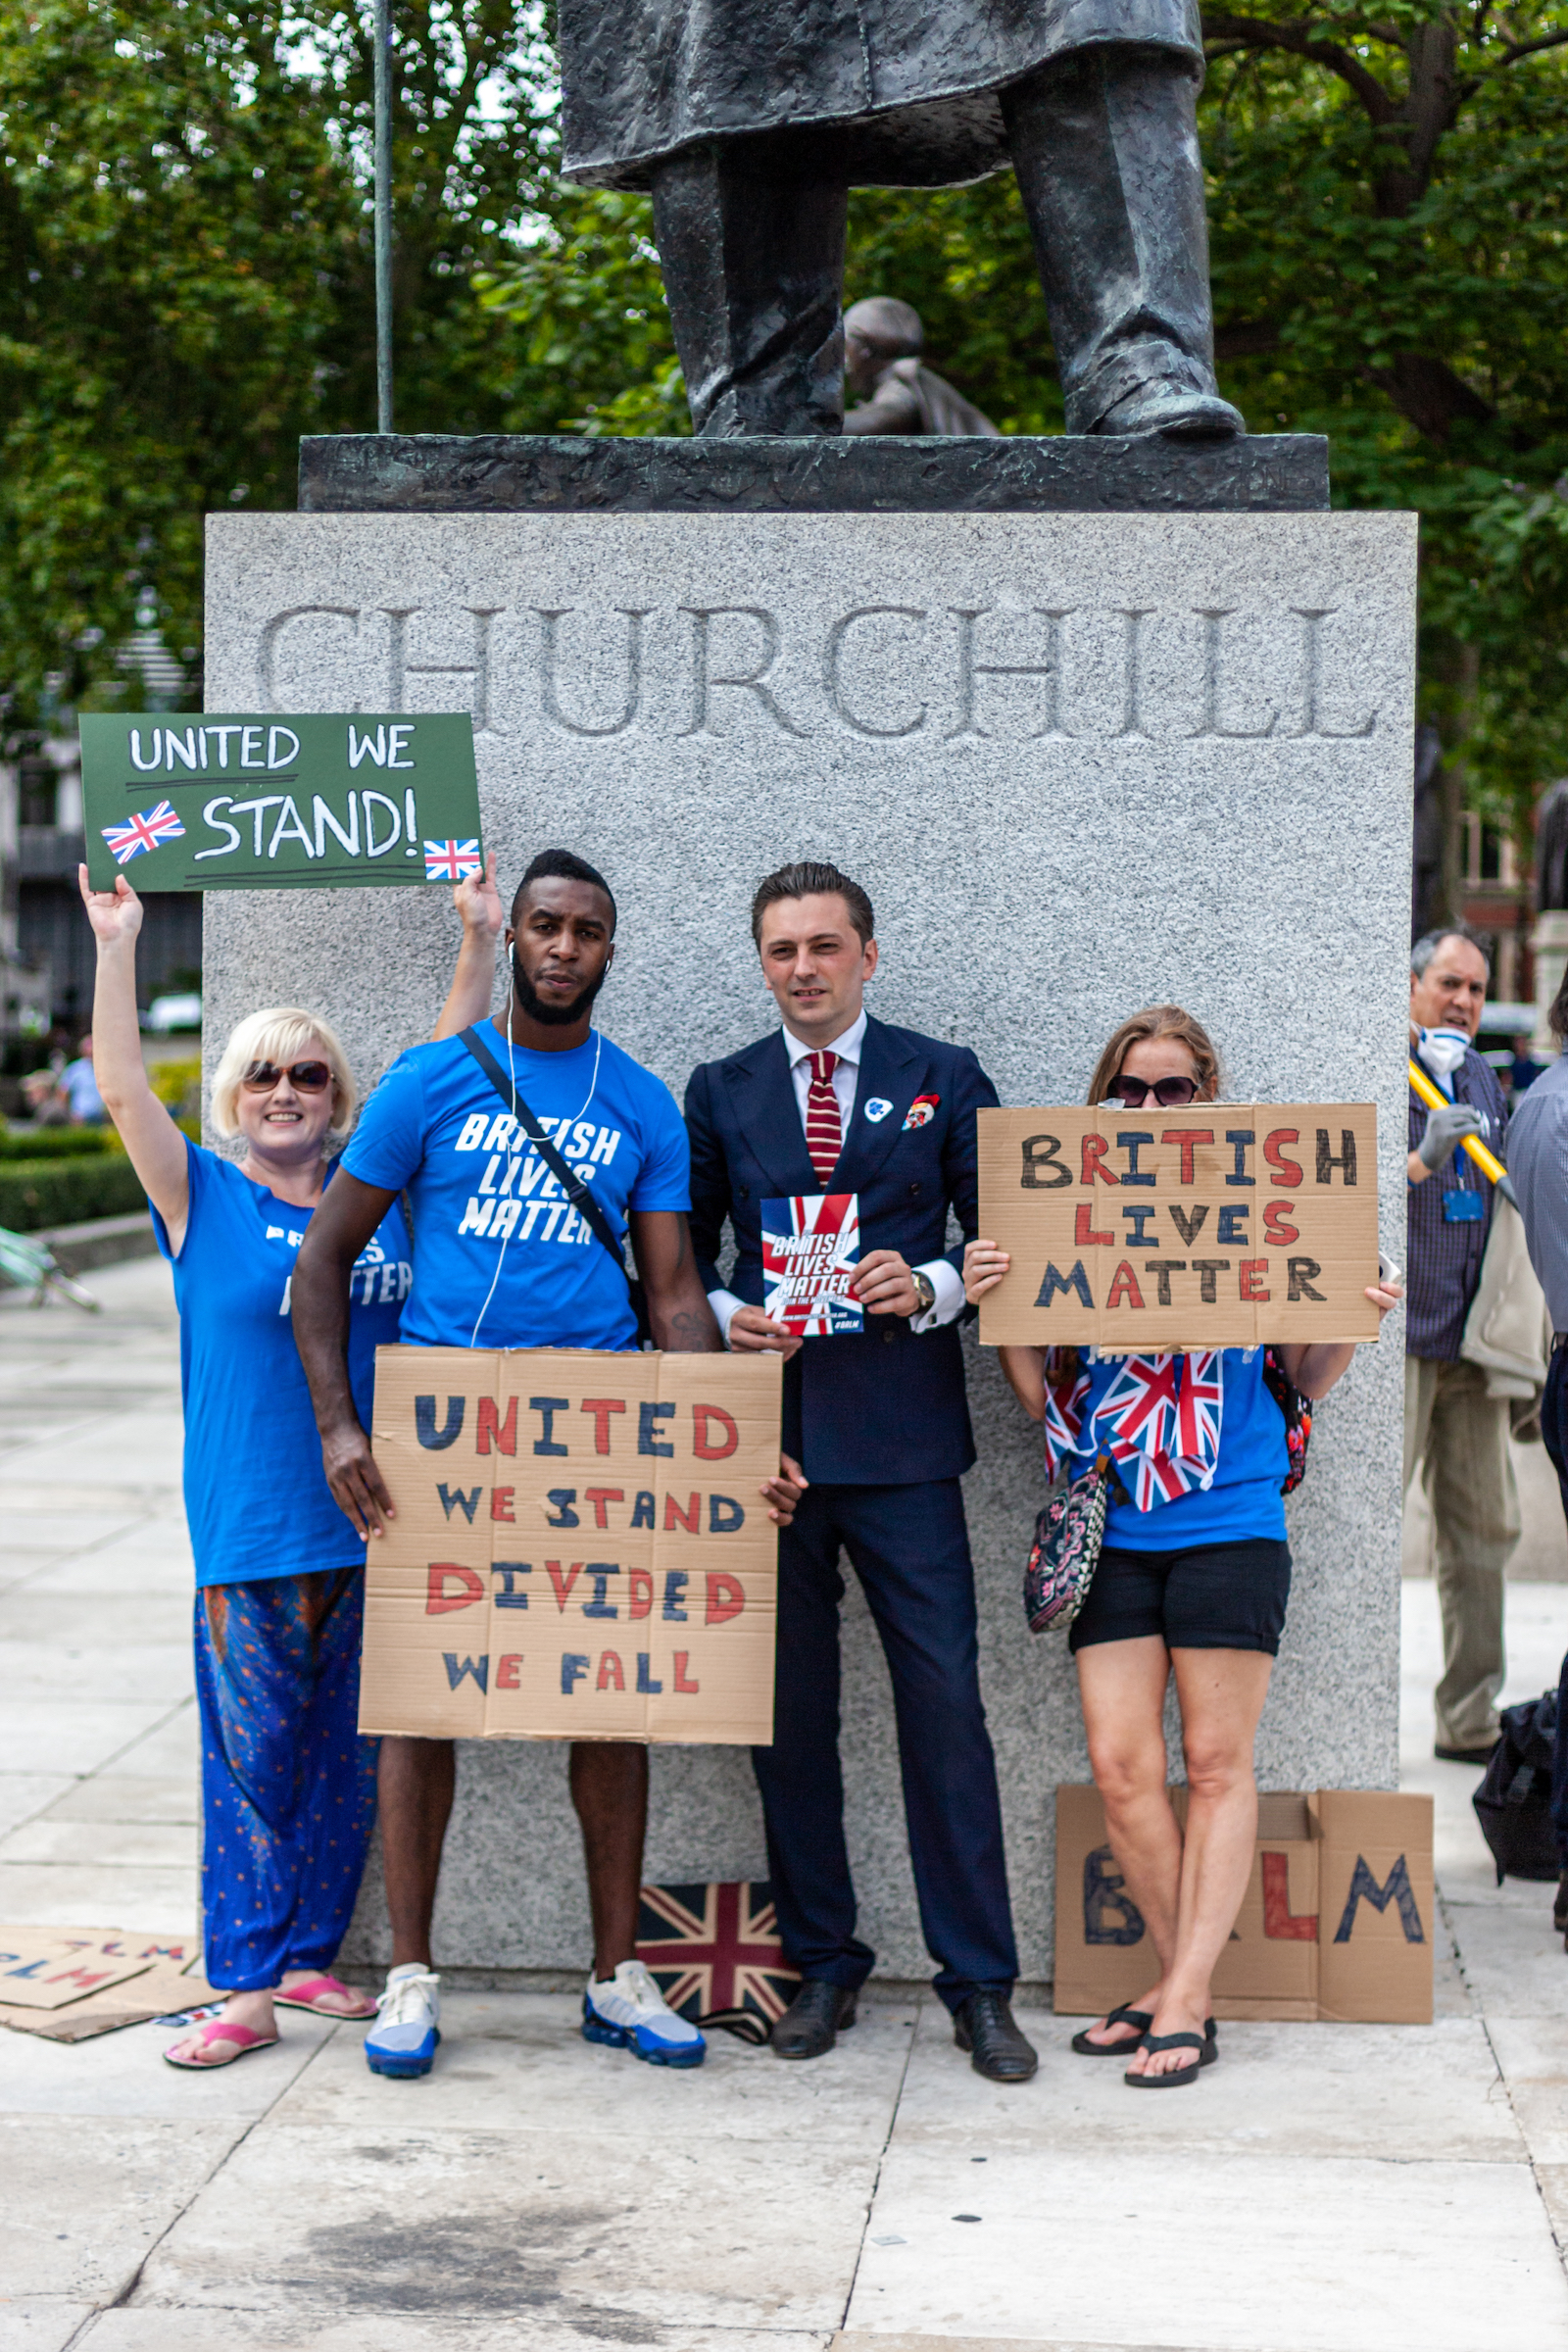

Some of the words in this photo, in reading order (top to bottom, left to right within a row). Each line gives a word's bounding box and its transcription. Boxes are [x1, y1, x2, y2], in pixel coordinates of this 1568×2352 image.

[258, 604, 1377, 739] CHURCHILL
[128, 724, 300, 772] UNITED
[348, 723, 416, 769] WE
[193, 787, 418, 860] STAND!
[1020, 1128, 1357, 1189] BRITISH
[771, 1233, 849, 1256] BRITISH
[1074, 1200, 1299, 1248] LIVES
[777, 1274, 850, 1298] MATTER
[786, 1254, 837, 1276] LIVES
[1033, 1256, 1328, 1309] MATTER
[415, 1395, 739, 1460] UNITED
[436, 1482, 516, 1525] WE
[545, 1486, 745, 1535] STAND
[425, 1560, 746, 1626] DIVIDED
[442, 1651, 524, 1696] WE
[561, 1649, 700, 1695] FALL
[1084, 1844, 1427, 1945] BLM
